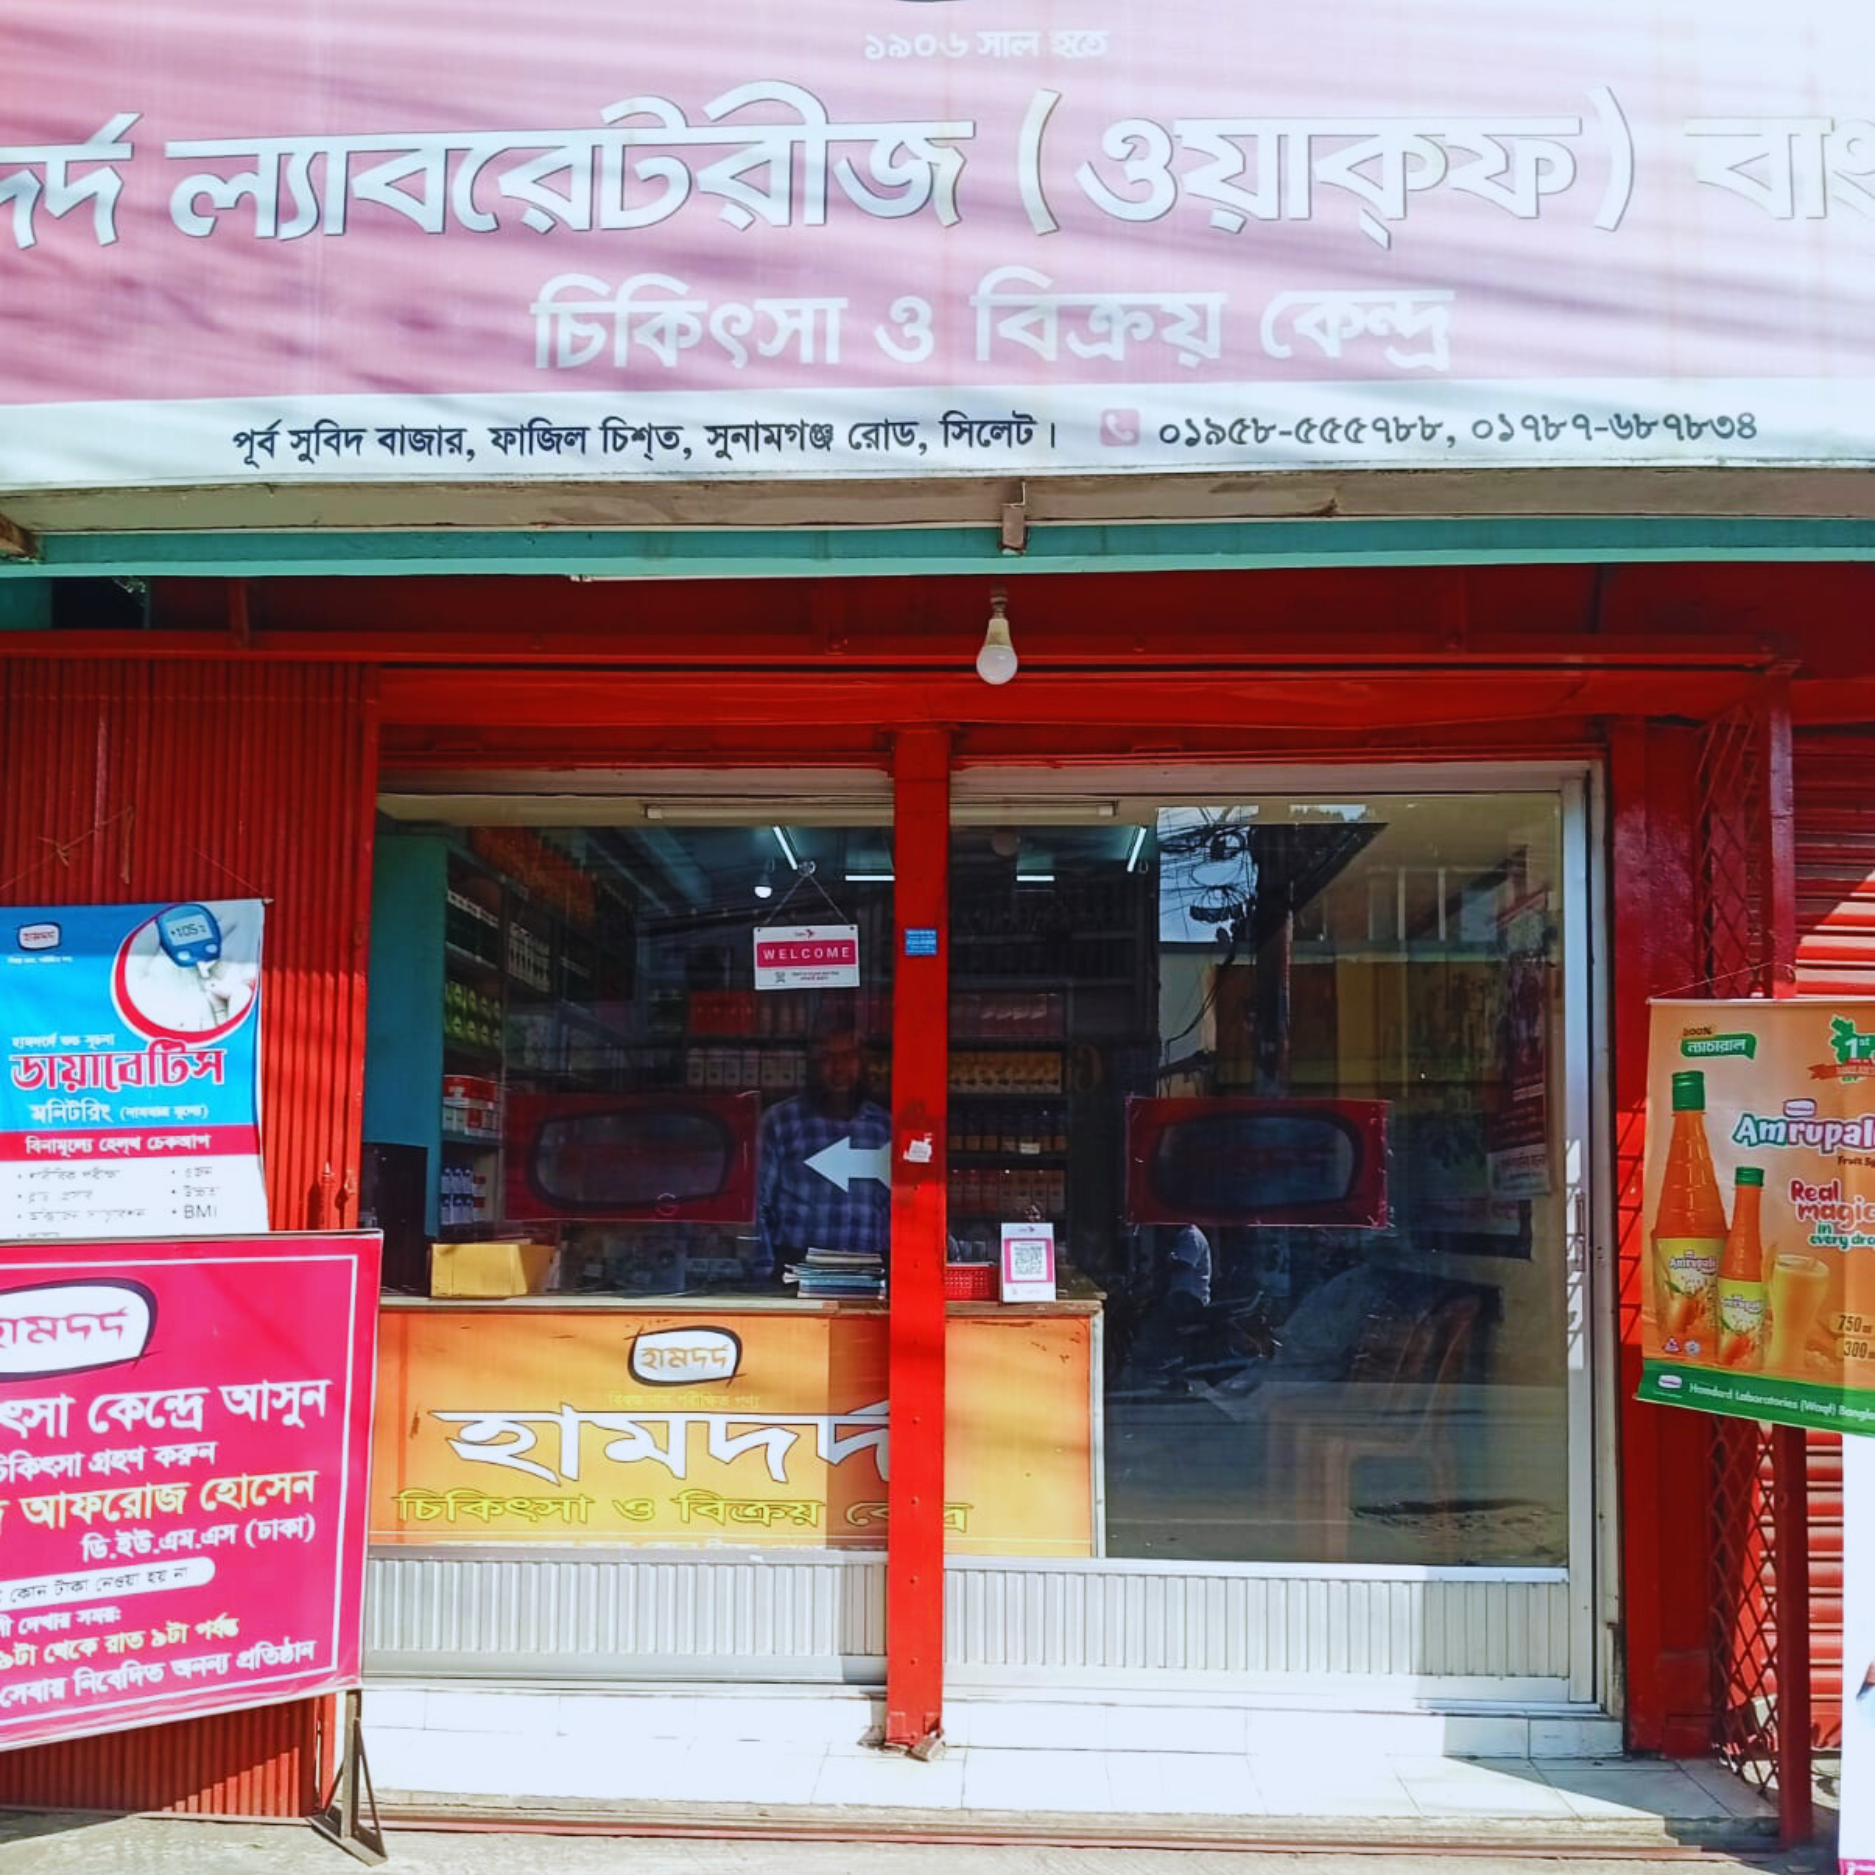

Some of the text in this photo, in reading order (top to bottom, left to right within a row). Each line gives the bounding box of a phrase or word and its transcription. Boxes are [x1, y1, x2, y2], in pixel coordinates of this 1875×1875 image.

[864, 33, 969, 60] ১৯০৬
[976, 31, 1041, 58] সাল
[165, 79, 977, 241] ল্যাবরেটরীজ
[530, 266, 1456, 372] চিকিৎসা ও বিক্রয় কেন্দ্র
[232, 419, 283, 469] পূর্ব
[288, 419, 367, 465] সুবিদ
[375, 425, 476, 462] বাজার,
[487, 416, 591, 456] ফাজিল
[703, 419, 835, 460] সুনামগঞ্জ
[848, 419, 928, 456] রোড,
[938, 410, 1039, 448] সিলেট
[1159, 411, 1457, 449] ০১৯৫৮-৫৫৫৭৮৮,
[1471, 410, 1758, 443] ০১৭৮৭-৬৮৭৮৩৪
[762, 946, 850, 961] WELCOME
[9, 1038, 226, 1092] ডায়াবেটিস
[28, 1097, 113, 1123] মনিটরিং
[1733, 1113, 1875, 1155] Amrupal
[1789, 1177, 1841, 1203] Real
[1796, 1195, 1875, 1231] magic
[1809, 1235, 1849, 1251] every
[1817, 1222, 1833, 1235] in
[1838, 1314, 1862, 1333] 750
[641, 1343, 730, 1370] হামদর্দ
[1843, 1340, 1868, 1359] 300
[87, 1387, 210, 1434] কেন্দ্রে
[218, 1379, 333, 1428] আসুন
[1735, 1389, 1798, 1409] Laboratories
[152, 1441, 218, 1467] করুন
[19, 1482, 191, 1530] আফরোজ
[200, 1470, 320, 1512] হোসেন
[391, 1487, 597, 1525] চিকিৎসা
[613, 1498, 655, 1523] ও
[669, 1489, 826, 1528] বিক্রয়
[245, 1513, 316, 1548] (ঢাকা)
[104, 1631, 145, 1654] রাত
[73, 1660, 164, 1696] নিবেদিত
[170, 1653, 231, 1679] অনন্য
[236, 1636, 317, 1670] প্রতিষ্ঠান
